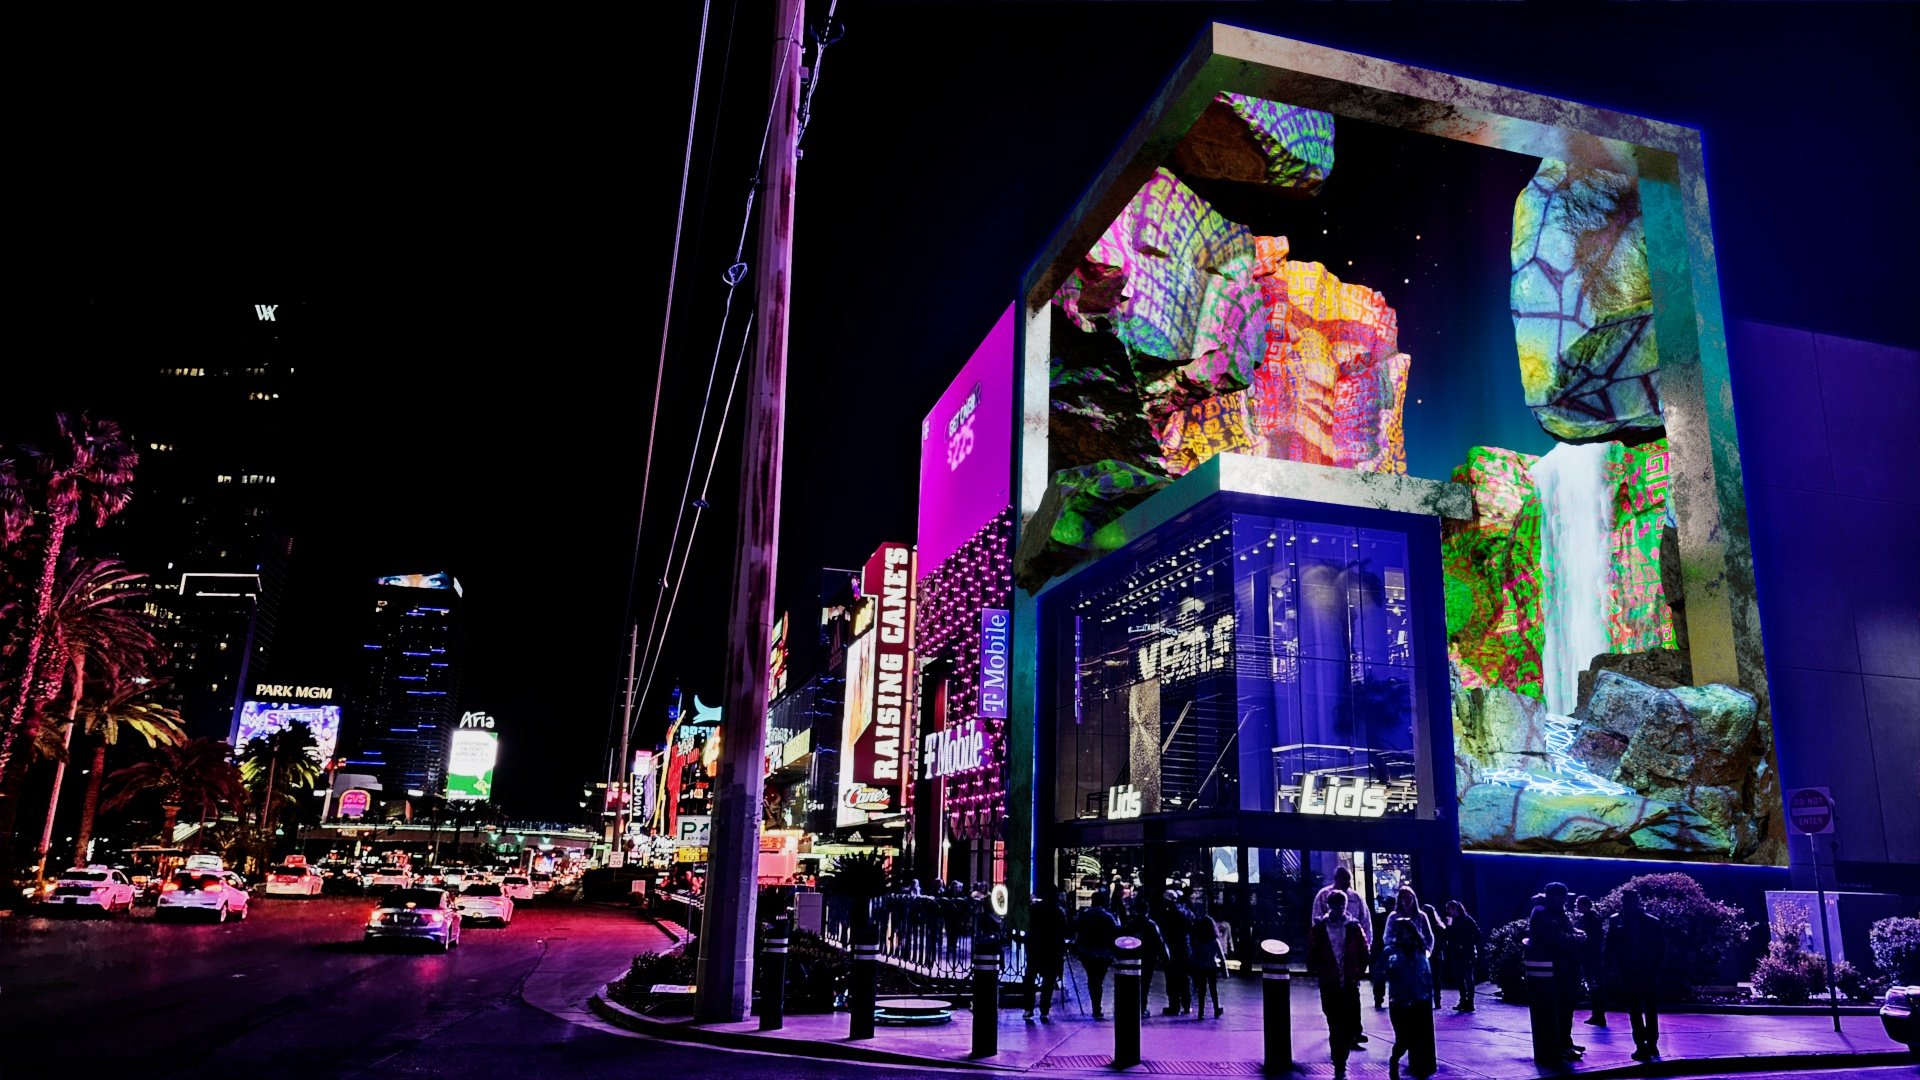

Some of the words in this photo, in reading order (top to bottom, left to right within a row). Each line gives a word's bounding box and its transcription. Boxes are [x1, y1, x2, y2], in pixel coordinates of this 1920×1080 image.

[881, 547, 909, 644] CANE'S
[256, 684, 293, 698] PARK
[295, 686, 333, 699] MGM
[459, 711, 495, 729] Aria
[874, 653, 904, 780] RAISING
[344, 793, 366, 804] CVS
[1108, 784, 1142, 820] Lids
[1301, 774, 1387, 818] Lids
[1794, 798, 1805, 806] DO
[1807, 797, 1823, 806] NOT
[1799, 816, 1823, 825] ENTER
